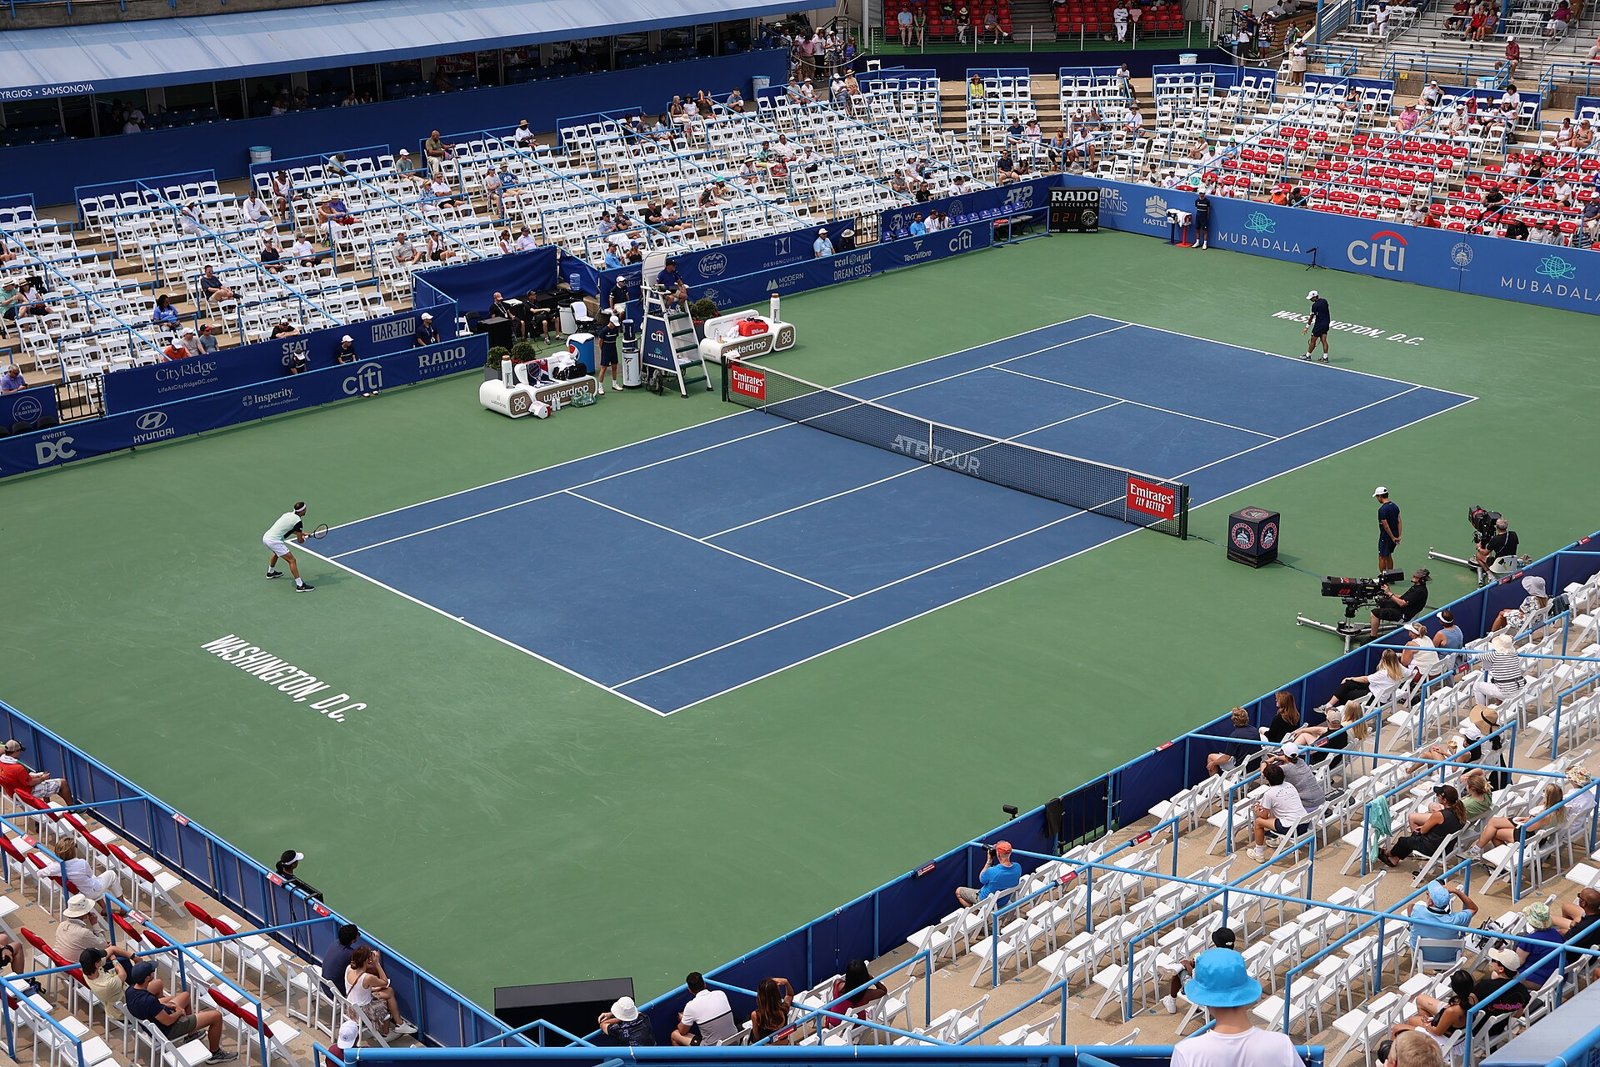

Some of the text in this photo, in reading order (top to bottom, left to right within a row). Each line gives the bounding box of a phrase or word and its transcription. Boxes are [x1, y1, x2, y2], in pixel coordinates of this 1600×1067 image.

[0, 84, 94, 99] YRGIOS SAMSONOVA
[1003, 185, 1034, 205] ATP
[1051, 191, 1098, 202] RADO
[1099, 197, 1128, 212] ENNIS
[1218, 231, 1301, 254] MUBADALA
[701, 260, 724, 273] Veroni
[833, 263, 872, 281] DREAM SEATS
[779, 273, 804, 284] MODERN
[373, 318, 415, 340] HAR-TRU
[282, 339, 309, 355] SEAT
[1386, 333, 1424, 346] D.C.
[281, 350, 311, 366] GK
[418, 346, 466, 368] RADO
[155, 360, 218, 381] CityRidge
[419, 360, 467, 375] SWITZERLAND
[733, 369, 764, 388] Emirates
[254, 388, 294, 404] Insperity
[745, 384, 759, 394] BETTER
[41, 430, 67, 440] events
[133, 427, 175, 443] HYUNDAI
[888, 434, 980, 476] ATP TOUR
[1130, 483, 1172, 505] Emirates
[1135, 497, 1165, 513] FLY BETTER
[309, 693, 367, 723] D.C.
